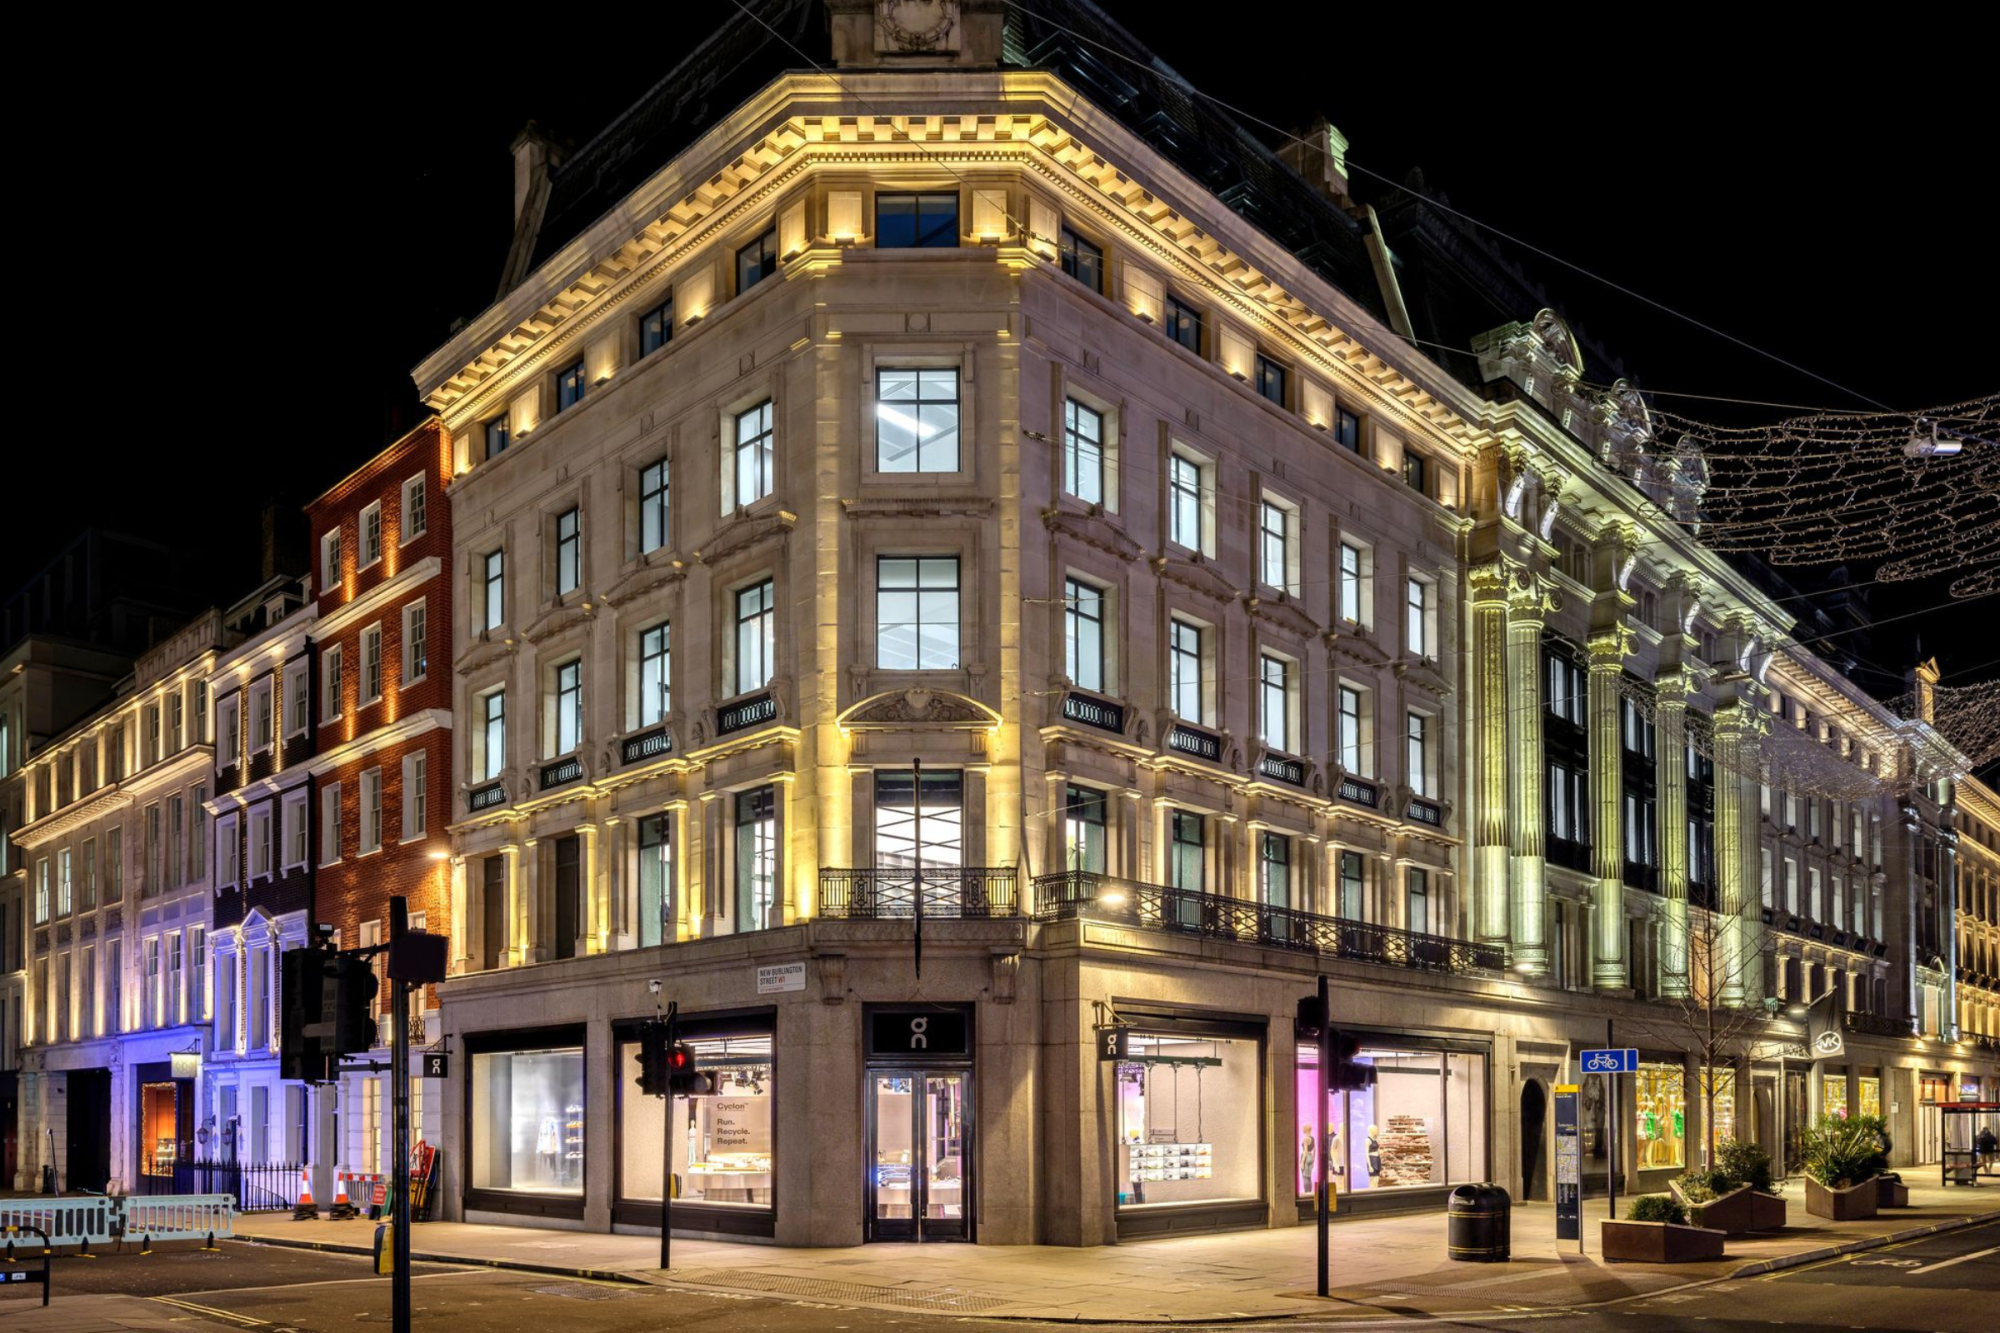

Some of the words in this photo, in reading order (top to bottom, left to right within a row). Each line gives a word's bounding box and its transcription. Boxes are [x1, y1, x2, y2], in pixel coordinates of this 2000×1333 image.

[772, 966, 802, 975] BURLINGTON
[760, 977, 776, 985] STREET
[717, 1118, 735, 1126] Run.
[717, 1127, 751, 1136] Recycle.
[717, 1137, 748, 1146] Repeat.
